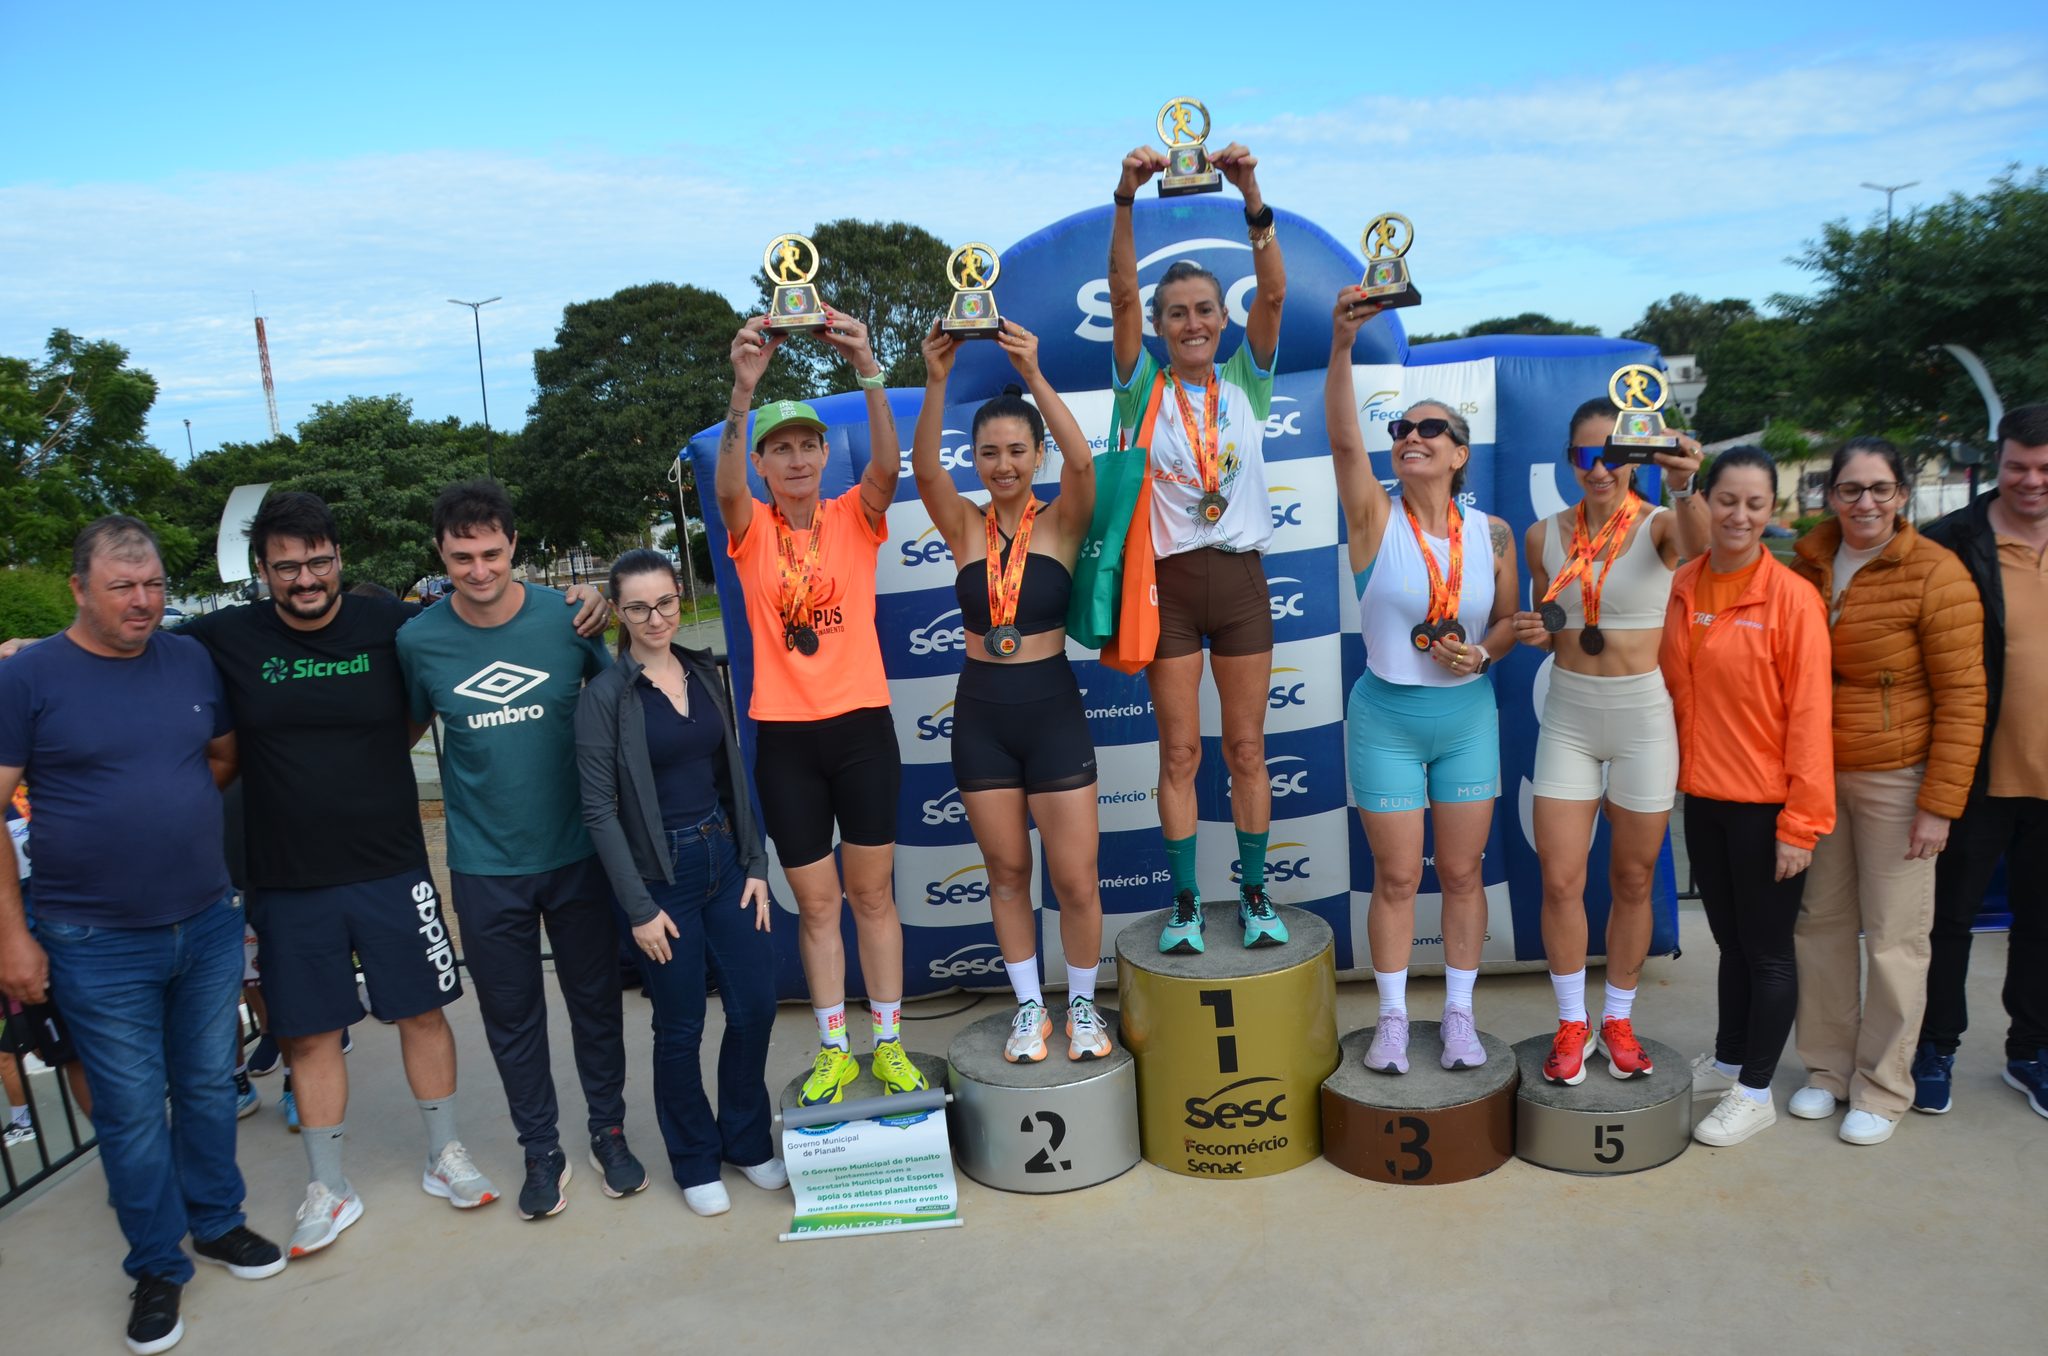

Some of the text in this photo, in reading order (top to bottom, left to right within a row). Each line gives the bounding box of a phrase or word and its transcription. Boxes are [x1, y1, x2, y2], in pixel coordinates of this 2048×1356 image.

[1264, 411, 1301, 438] sc
[292, 653, 370, 680] Sicredi
[468, 704, 544, 729] umbro
[1380, 797, 1414, 808] RUN
[1152, 869, 1171, 882] RS
[411, 880, 456, 992] adidas
[1199, 989, 1238, 1074] 1
[1184, 1094, 1287, 1129] Sesc
[787, 1134, 859, 1150] Governo Municipal
[803, 1146, 846, 1158] de Planalto
[1020, 1111, 1072, 1174] 2
[1185, 1135, 1289, 1156] Fecomércio
[1384, 1116, 1433, 1181] 3
[1593, 1124, 1625, 1164] 5
[811, 1166, 848, 1175] Governo
[849, 1159, 891, 1170] Municipal
[905, 1153, 941, 1163] Planalto
[1187, 1158, 1243, 1174] Senac
[806, 1182, 850, 1191] Secretaria
[851, 1176, 892, 1187] Municipal
[906, 1172, 944, 1181] Esportes
[835, 1170, 884, 1180] juntamente
[817, 1192, 841, 1202] apoia
[854, 1188, 883, 1198] atletas
[884, 1183, 938, 1196] planaltenses
[825, 1203, 849, 1211] estão
[850, 1199, 892, 1209] presentes
[894, 1197, 917, 1205] neste
[919, 1194, 949, 1203] evento
